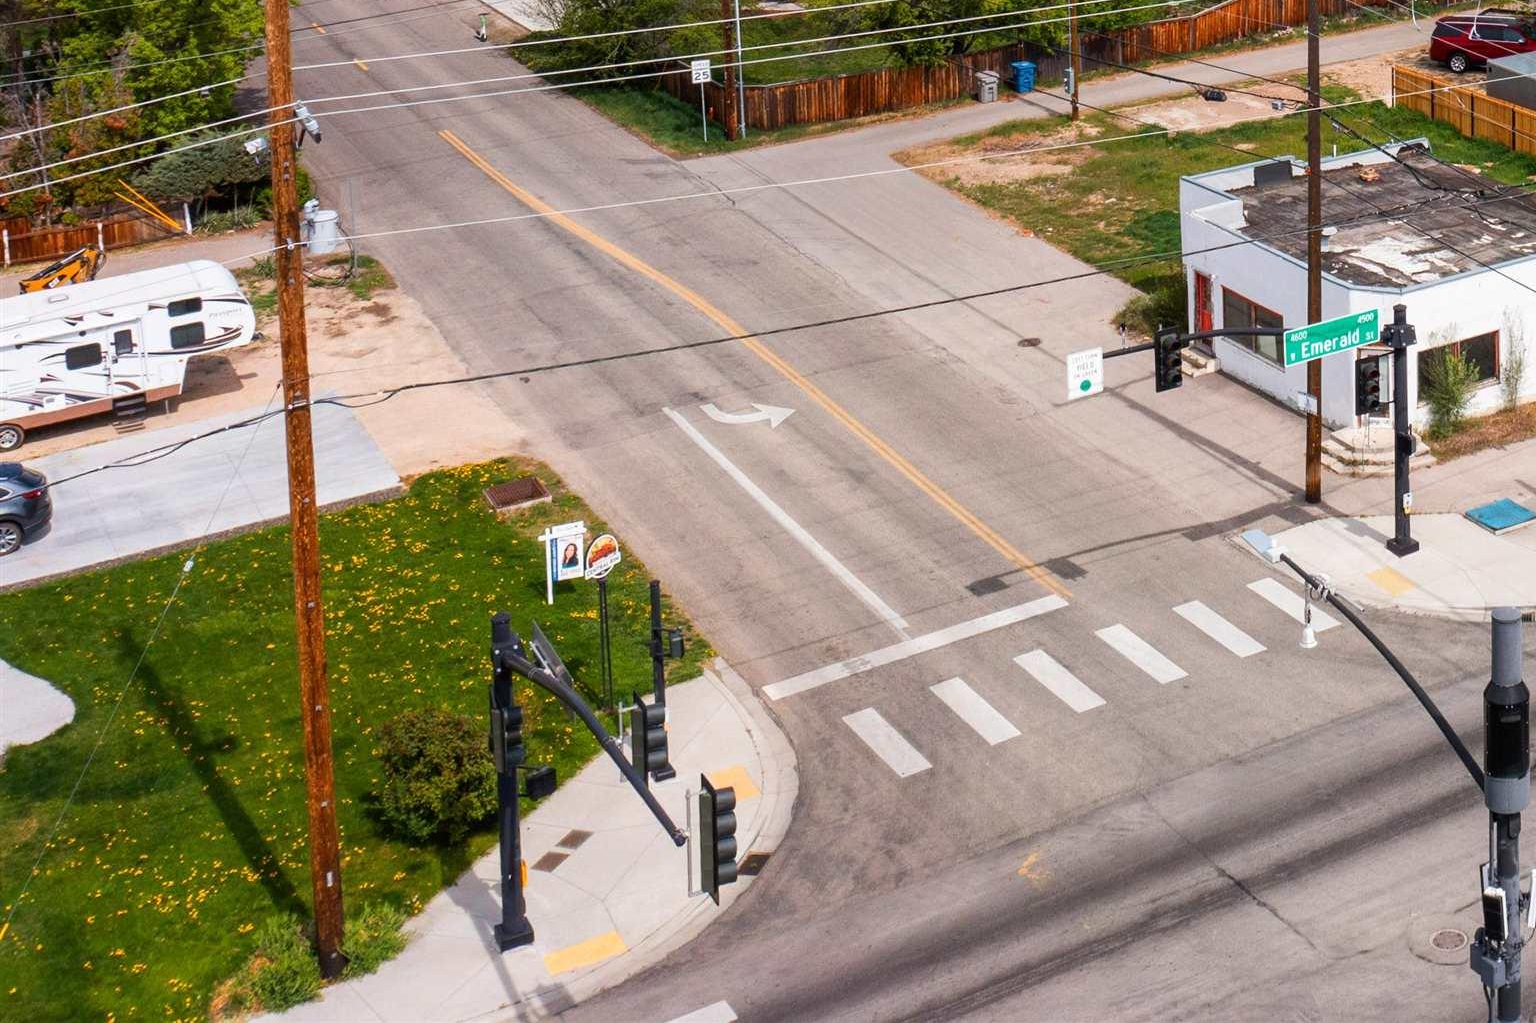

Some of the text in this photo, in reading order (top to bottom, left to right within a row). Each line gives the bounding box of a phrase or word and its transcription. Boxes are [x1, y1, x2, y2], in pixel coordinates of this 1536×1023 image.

[695, 71, 710, 80] 25
[1357, 312, 1374, 324] 4500
[1290, 330, 1308, 342] 4600
[1301, 328, 1360, 359] Emerald
[1365, 331, 1375, 340] St
